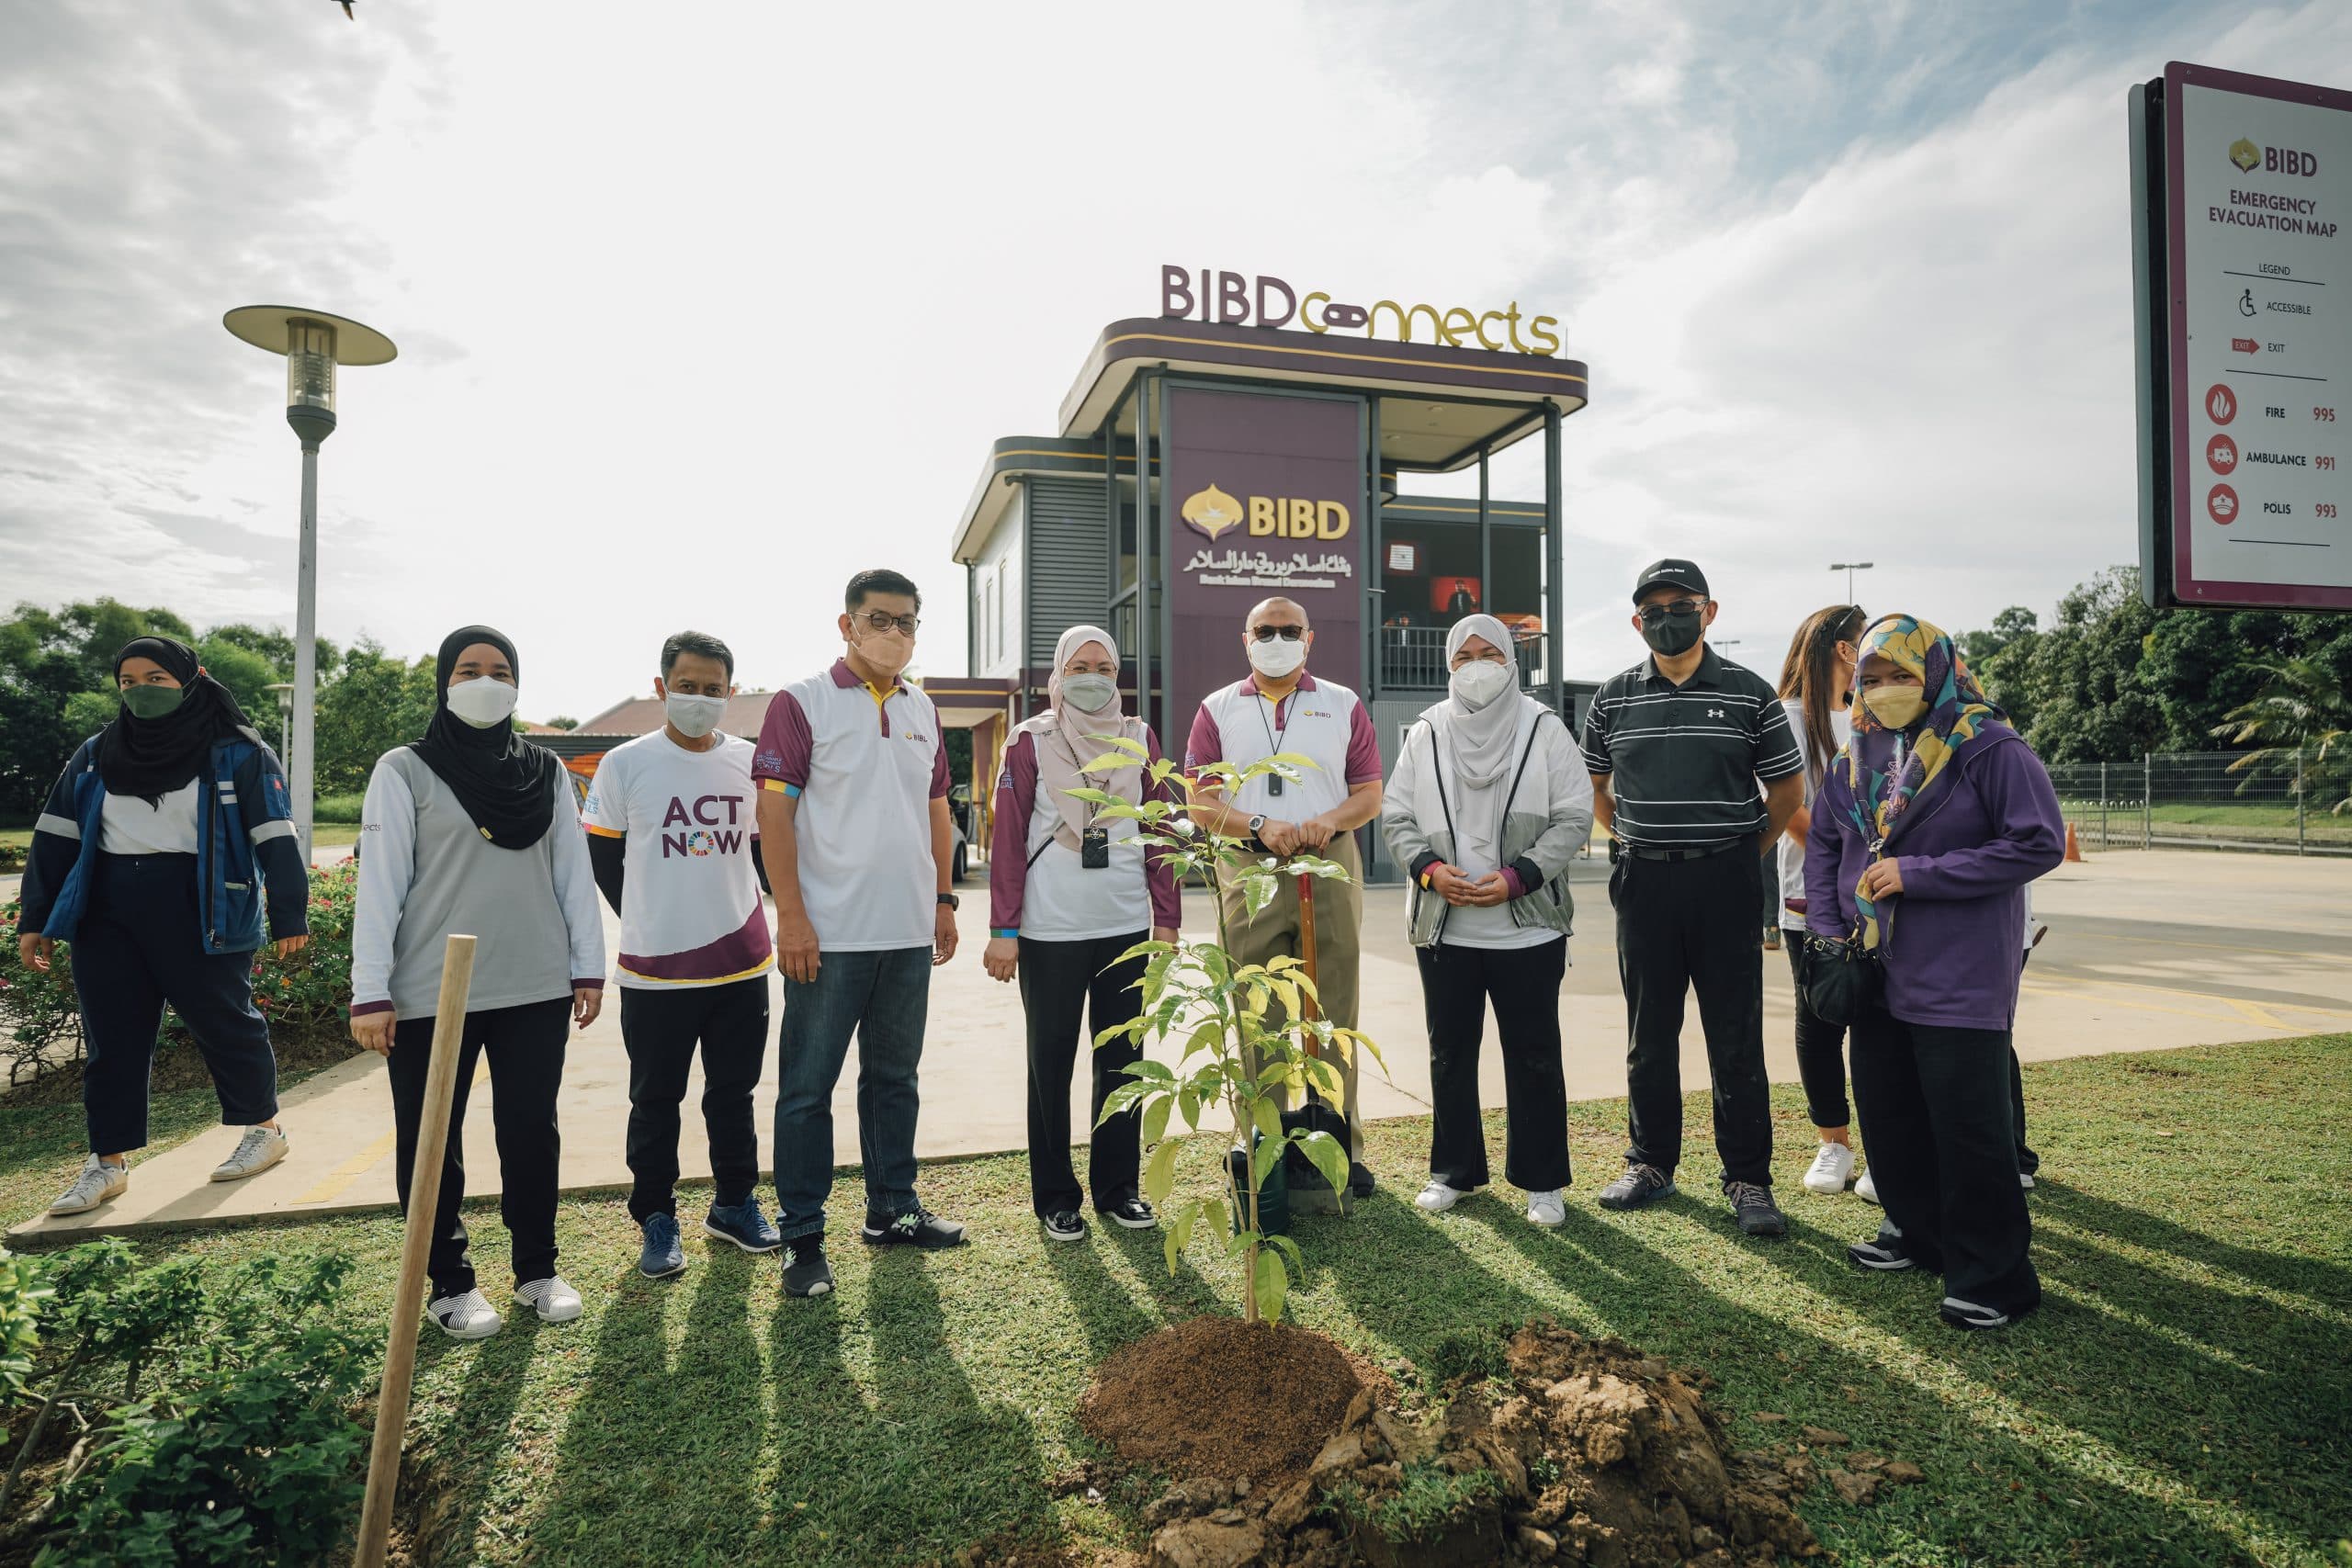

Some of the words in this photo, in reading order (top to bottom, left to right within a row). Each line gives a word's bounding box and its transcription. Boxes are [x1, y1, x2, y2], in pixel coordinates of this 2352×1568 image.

[2265, 146, 2317, 177] BIBD
[2230, 189, 2316, 215] EMERGENCY
[2209, 207, 2302, 234] EVACUATION
[2307, 220, 2337, 238] MAP
[2258, 263, 2290, 276] LEGEND
[2267, 301, 2312, 315] ACCESSIBLE
[2234, 342, 2250, 350] EXIT
[2267, 343, 2285, 353] EXIT
[2266, 407, 2286, 419] FIRE
[2312, 407, 2335, 422] 995
[2245, 452, 2307, 467] AMBULANCE
[2314, 456, 2335, 470] 991
[1249, 496, 1351, 540] BIBD
[2263, 502, 2291, 514] POLIS
[2315, 503, 2336, 518] 993
[662, 795, 743, 829] ACT
[662, 830, 742, 859] NOW
